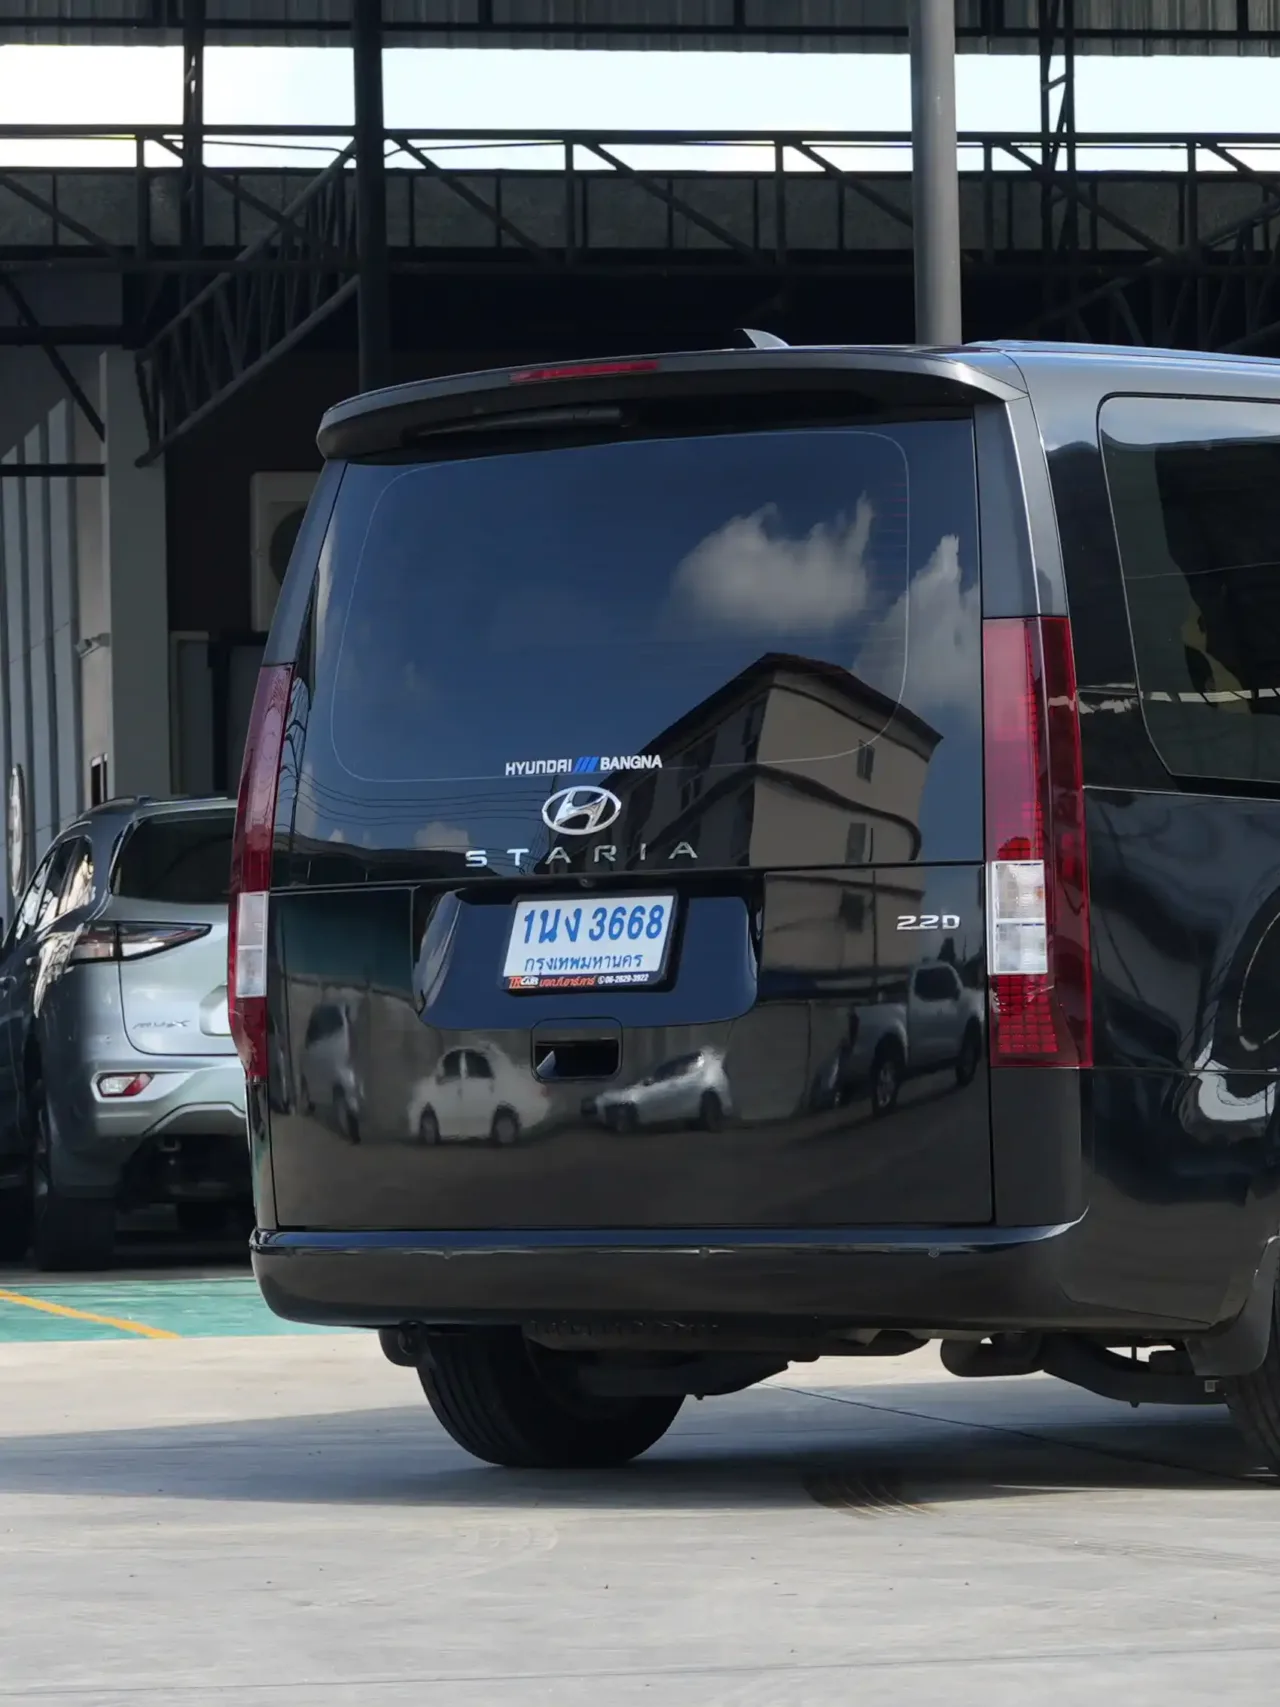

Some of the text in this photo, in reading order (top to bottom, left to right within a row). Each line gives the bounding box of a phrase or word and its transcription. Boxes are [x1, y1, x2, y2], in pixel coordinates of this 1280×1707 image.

[505, 754, 662, 776] HYUNDAI BANGNA
[465, 841, 698, 868] STARIA
[524, 904, 664, 944] 1นง 3668
[896, 914, 960, 930] 22D
[524, 953, 643, 976] กรุงเทพมหานคร
